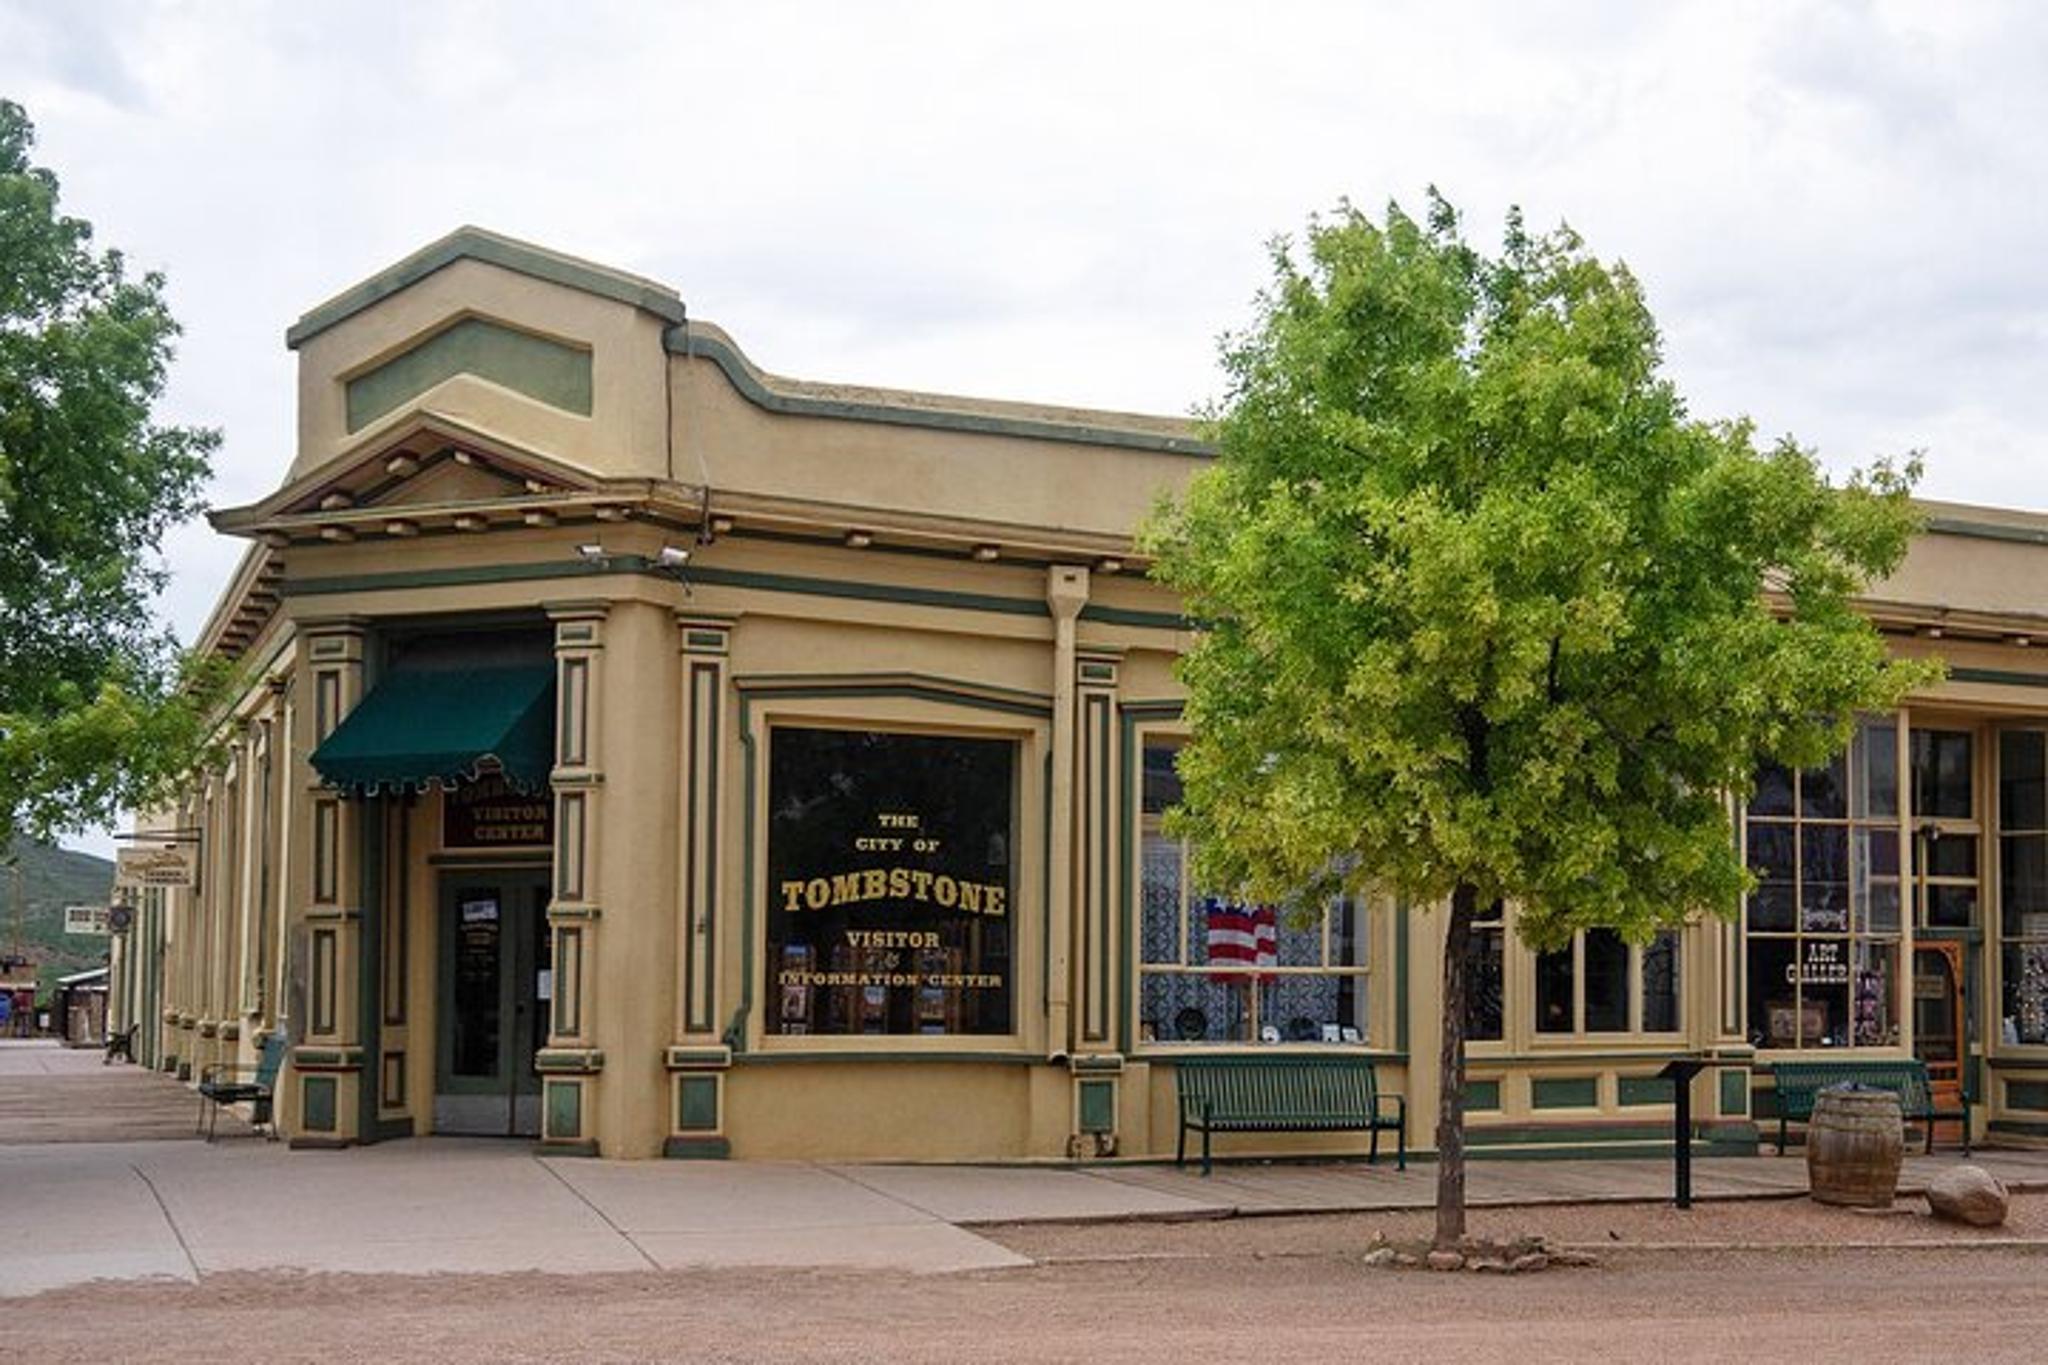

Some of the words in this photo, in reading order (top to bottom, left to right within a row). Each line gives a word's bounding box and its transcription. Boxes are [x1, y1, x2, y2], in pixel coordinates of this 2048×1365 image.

[472, 806, 546, 820] VISITOR
[878, 814, 919, 828] THE
[474, 826, 545, 840] CENTER
[855, 838, 903, 851] CITY
[913, 838, 940, 852] OF
[782, 867, 1006, 916] TOMBSTONE
[847, 931, 939, 948] VISITOR
[1808, 943, 1838, 962] ART
[778, 971, 919, 986] INFORMATION
[929, 973, 1003, 987] CENTER
